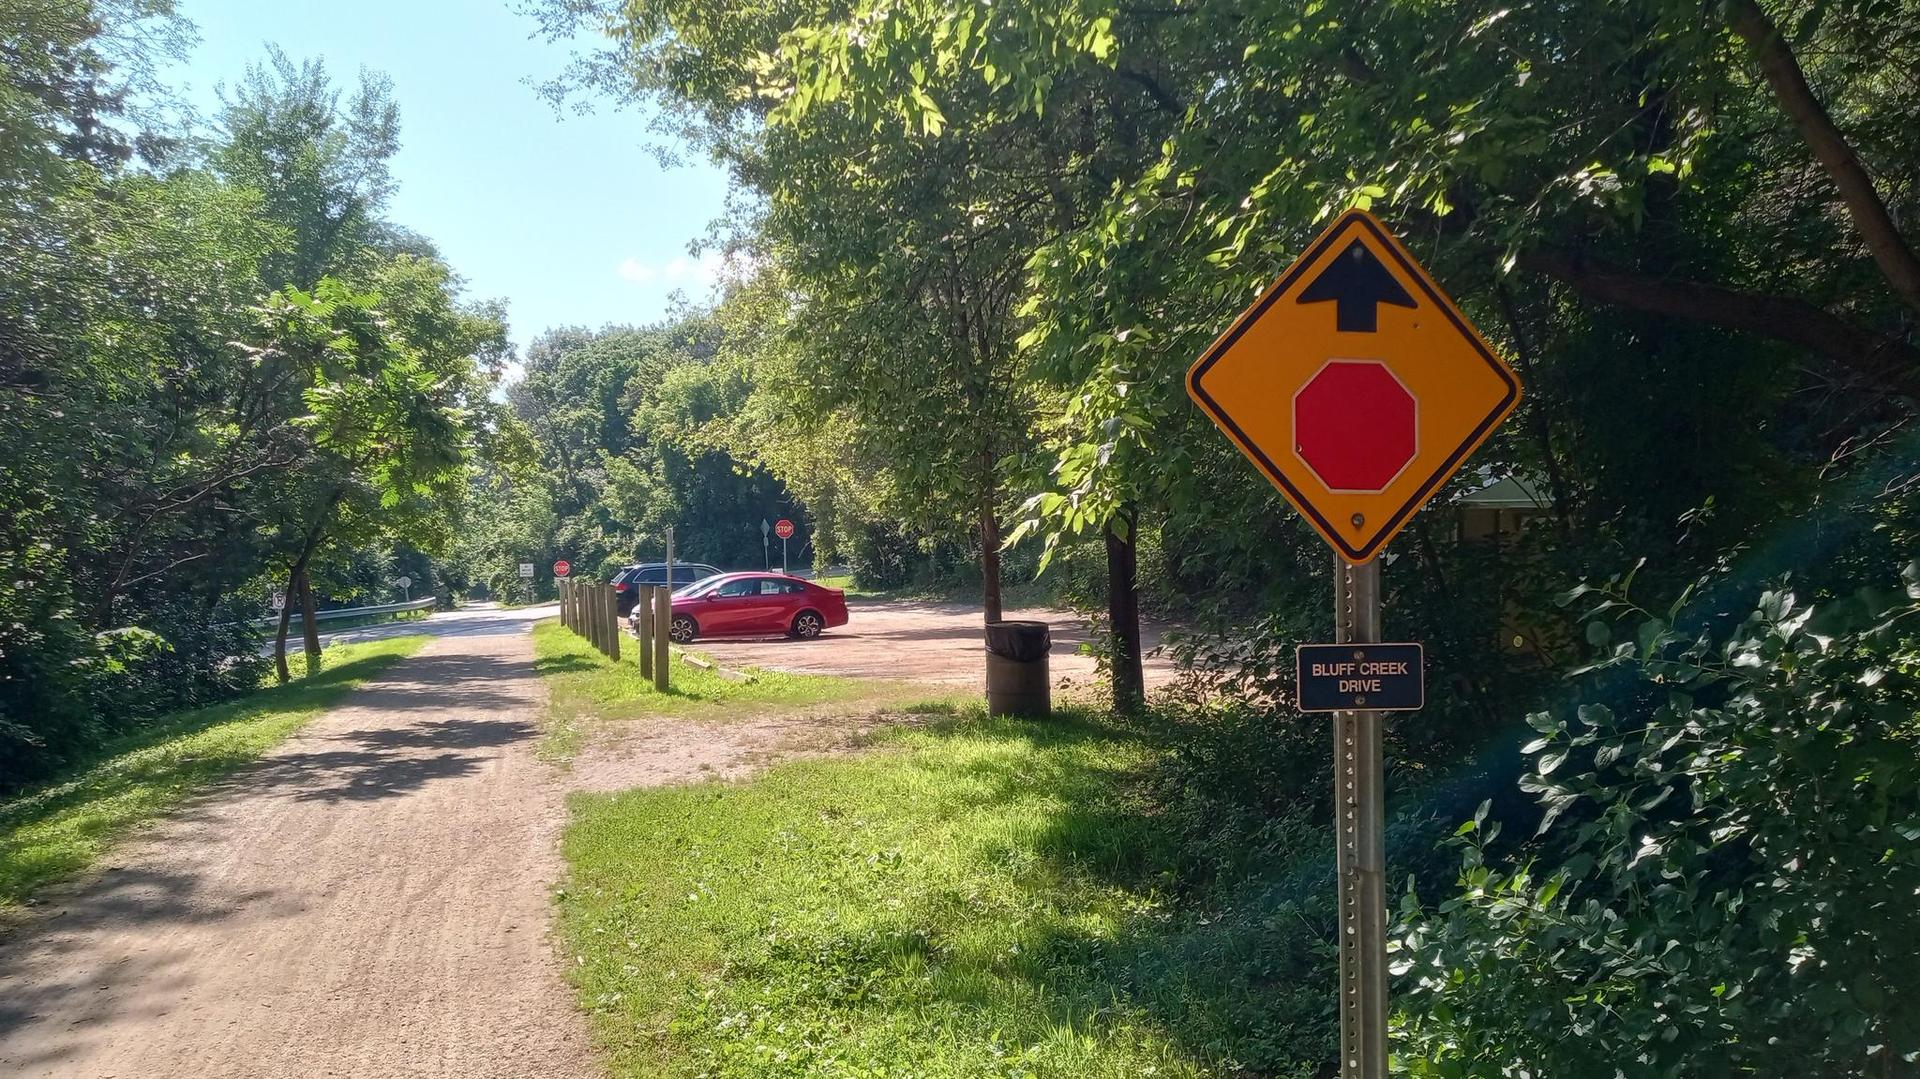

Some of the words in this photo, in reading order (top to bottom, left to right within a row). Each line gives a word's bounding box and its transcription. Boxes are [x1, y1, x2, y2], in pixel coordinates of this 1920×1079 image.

[776, 525, 793, 533] STOP
[1312, 663, 1355, 676] BLUFF
[1360, 662, 1408, 675] CREEK
[1339, 680, 1381, 692] DRIVE
